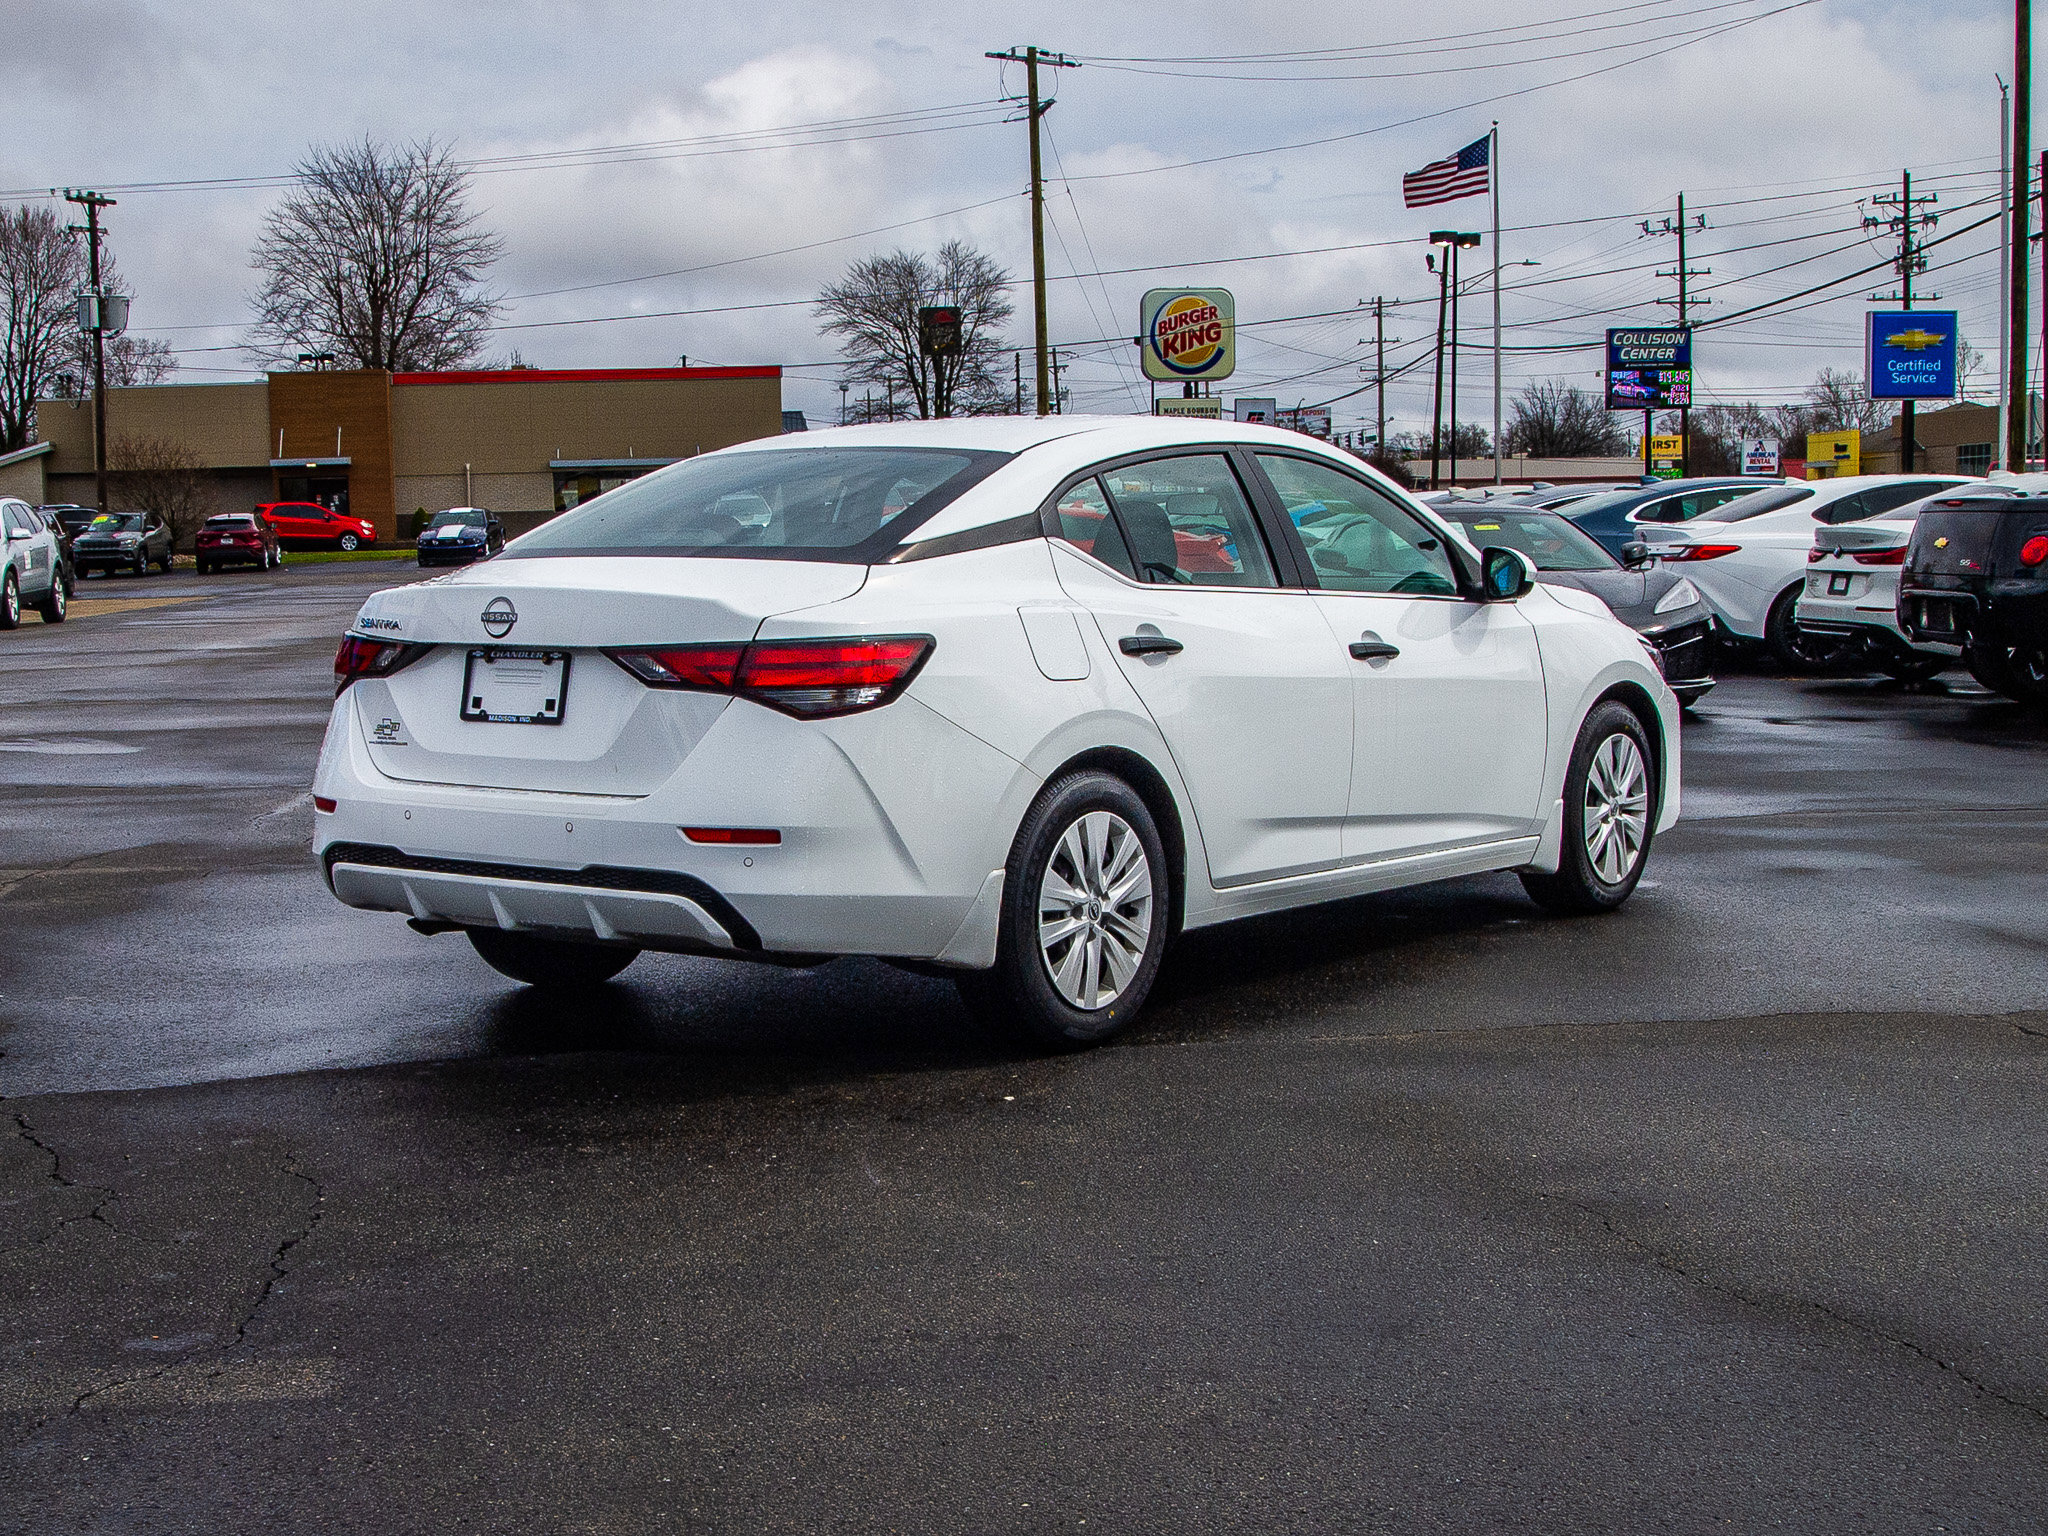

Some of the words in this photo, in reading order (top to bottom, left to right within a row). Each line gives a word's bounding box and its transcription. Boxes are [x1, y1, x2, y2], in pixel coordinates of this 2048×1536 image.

[1157, 305, 1218, 337] BURGER
[1161, 321, 1222, 360] KING
[1613, 332, 1686, 345] COLLISION
[1620, 347, 1676, 360] CENTER
[1887, 359, 1941, 371] Certified
[1891, 372, 1937, 383] Service
[1186, 406, 1218, 414] BOURBON
[1652, 440, 1679, 449] IRST
[481, 612, 517, 621] NISSAN
[360, 617, 402, 630] SENTRA
